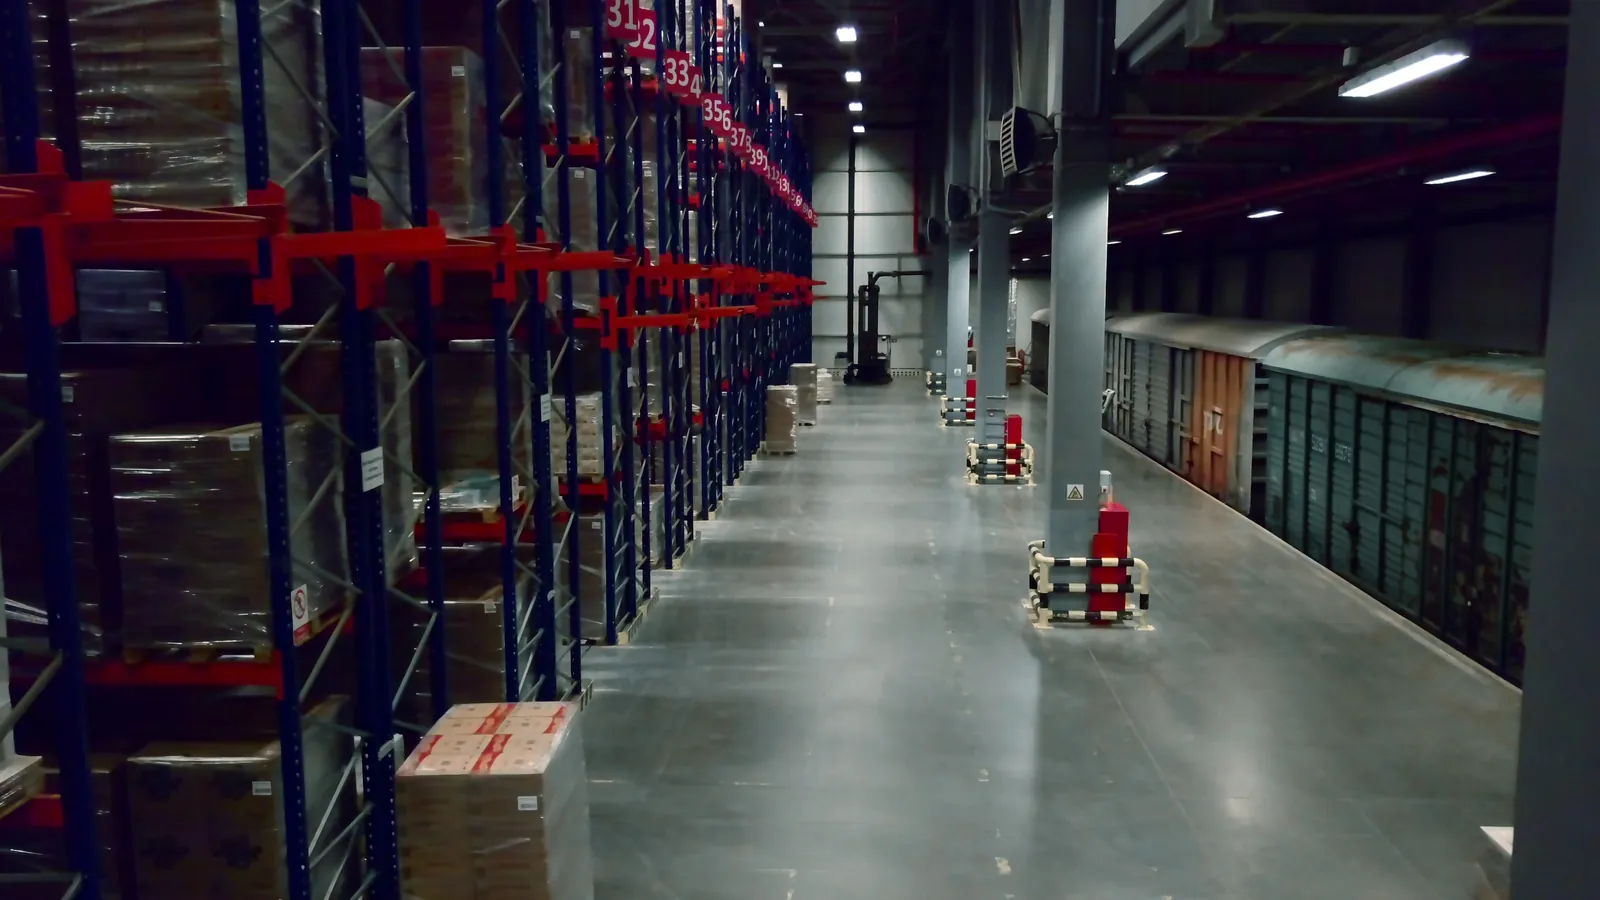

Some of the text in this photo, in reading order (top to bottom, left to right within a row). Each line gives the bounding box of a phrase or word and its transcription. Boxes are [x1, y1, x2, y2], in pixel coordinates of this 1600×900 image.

[608, 0, 637, 30] 31
[666, 58, 689, 87] 33
[690, 74, 702, 99] 4
[704, 98, 723, 122] 35
[722, 109, 731, 131] 6
[730, 127, 746, 147] 37
[750, 148, 763, 165] 39
